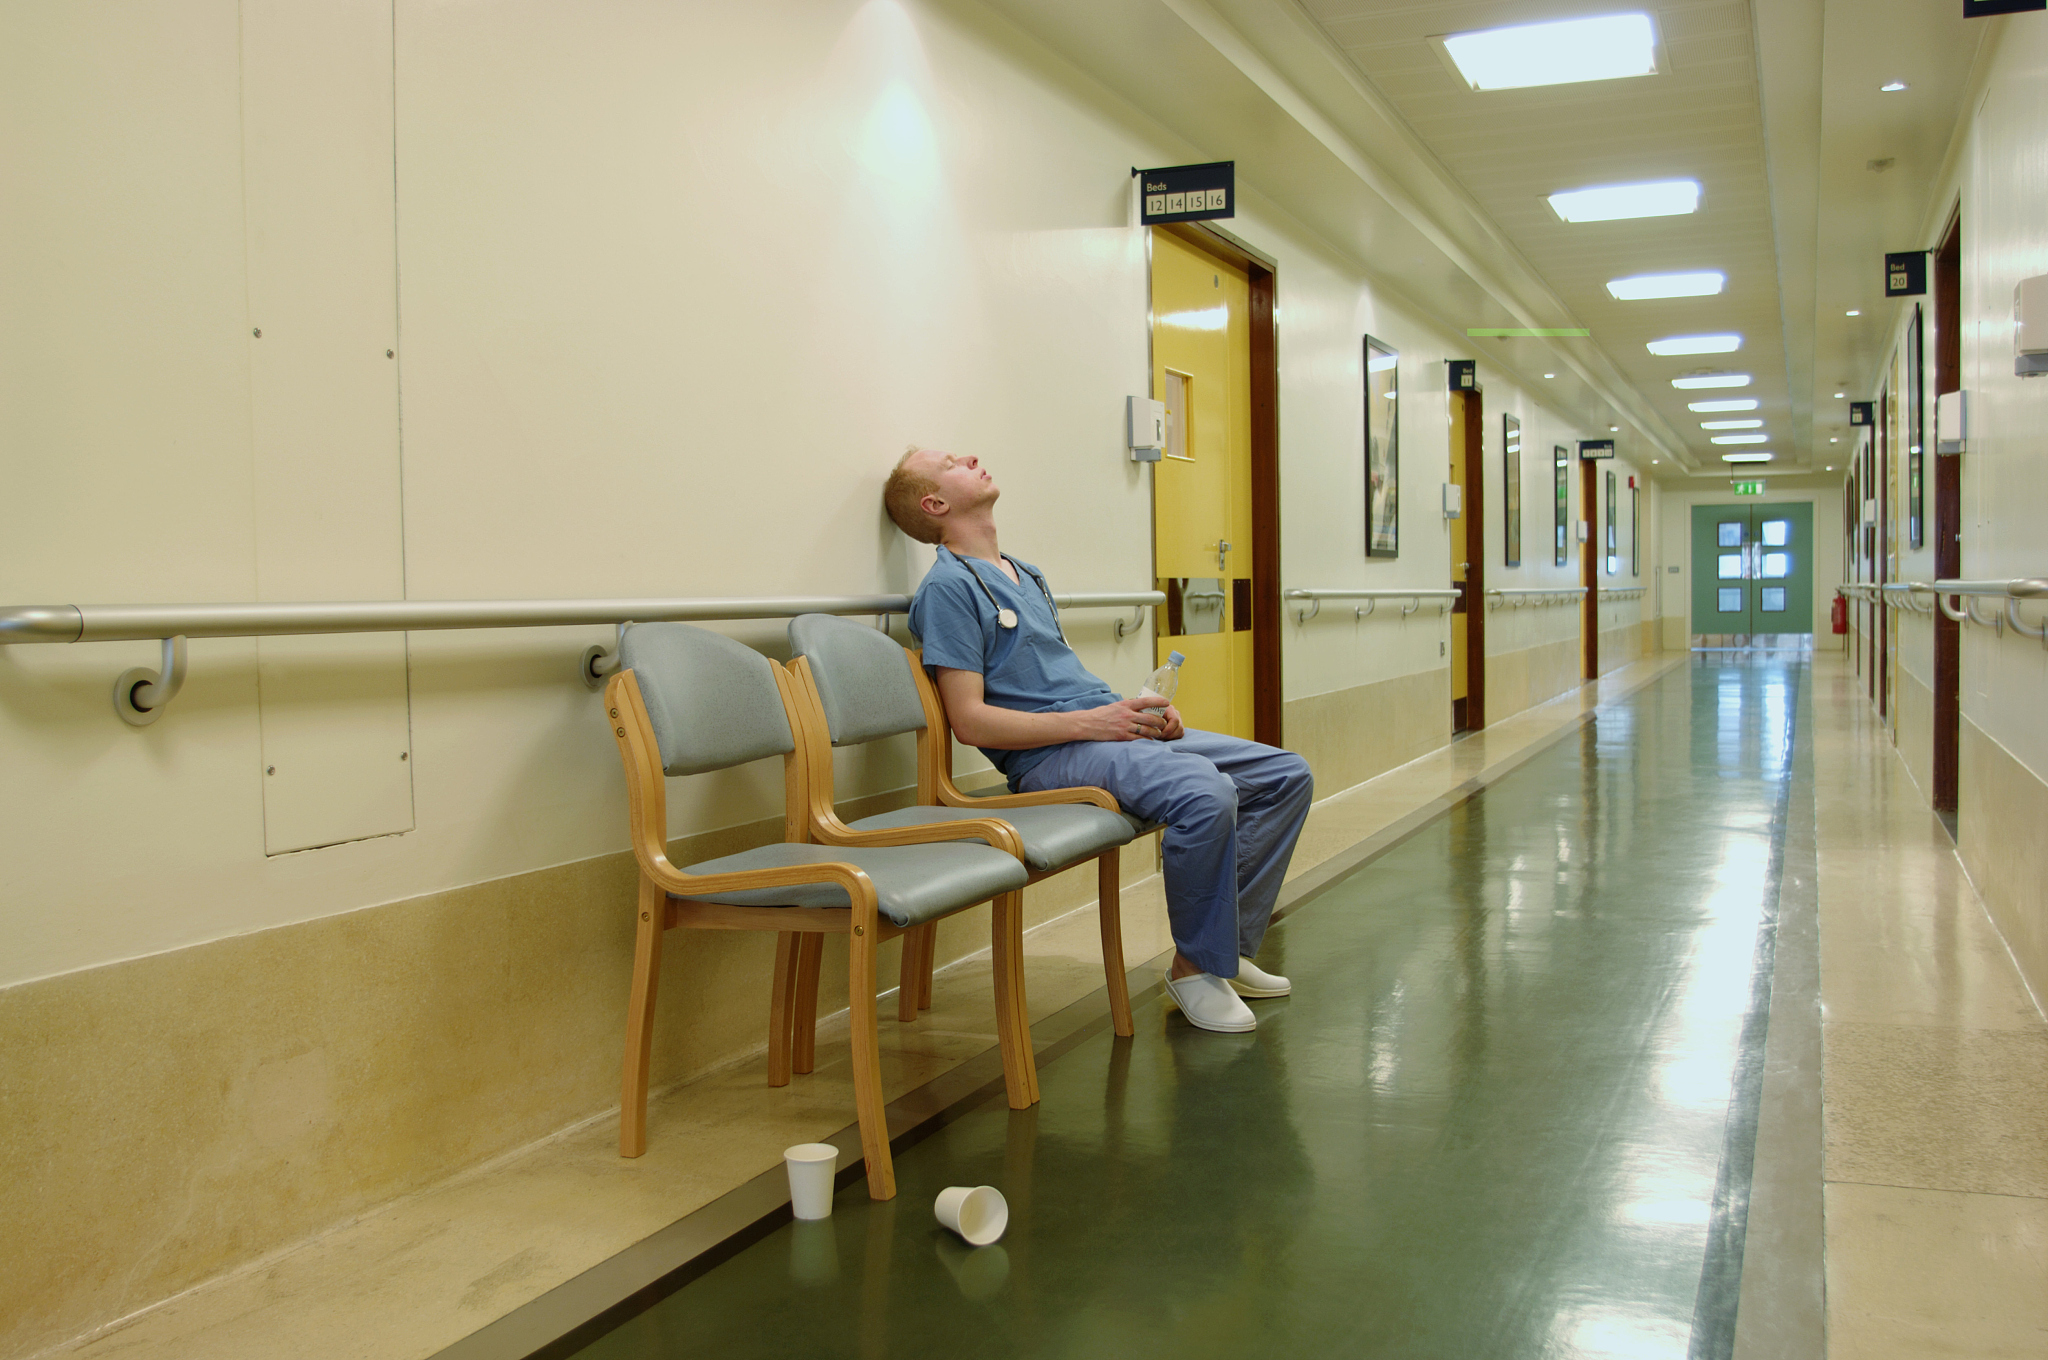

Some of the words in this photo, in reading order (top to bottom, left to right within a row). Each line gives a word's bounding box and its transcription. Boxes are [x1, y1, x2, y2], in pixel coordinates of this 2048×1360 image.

[1146, 182, 1167, 192] Beds
[1150, 200, 1163, 212] 12
[1170, 198, 1183, 210] 14
[1190, 196, 1203, 208] 15
[1211, 194, 1223, 206] 16
[1890, 263, 1905, 271] Bed
[1892, 277, 1905, 287] 20
